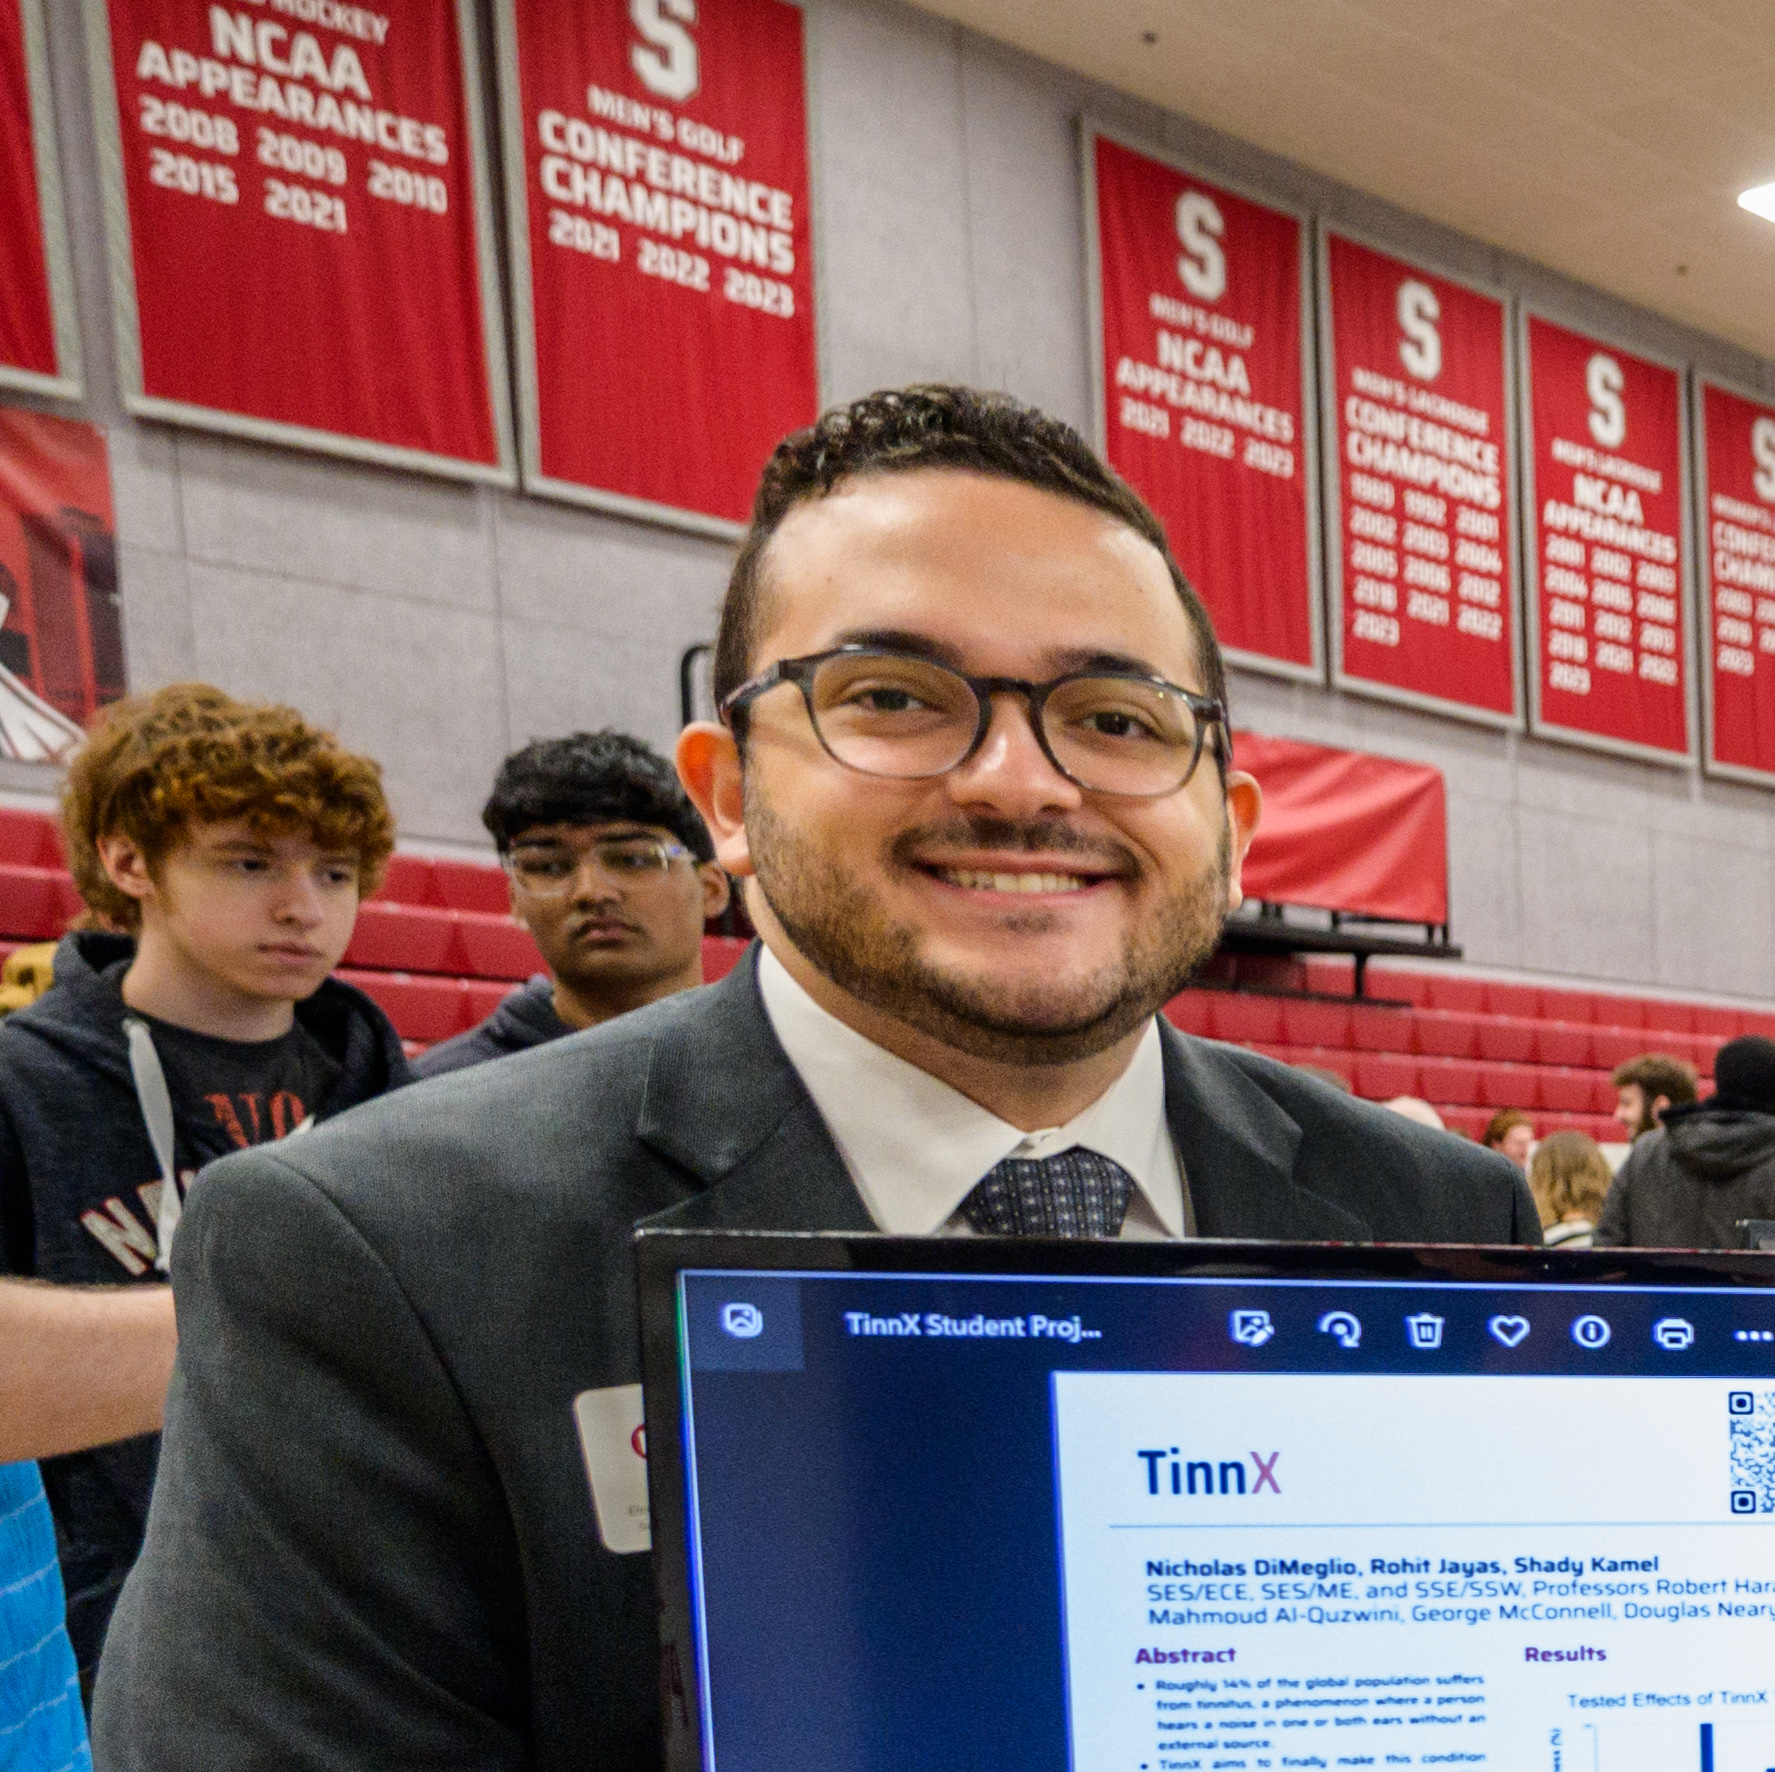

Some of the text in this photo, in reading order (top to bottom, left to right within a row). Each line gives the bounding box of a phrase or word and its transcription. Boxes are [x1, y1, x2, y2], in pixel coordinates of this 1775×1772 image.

[209, 4, 373, 100] NCAA
[628, 0, 699, 102] S
[137, 39, 450, 165] APPEARANCES
[588, 84, 744, 165] MEN'S GOLF
[139, 94, 448, 215] 2008 2009 2010
[151, 148, 347, 234] 2015 2021
[537, 108, 794, 231] CONFERENCE
[540, 153, 795, 275] CHAMPIONS
[1175, 190, 1227, 303] S
[549, 208, 795, 319] 2021 2022 2023
[1150, 292, 1209, 335] MEN'S
[1396, 279, 1442, 382] S
[1116, 356, 1294, 443] APPEARANCES
[1156, 329, 1250, 396] NCAA
[1586, 353, 1626, 448] S
[1345, 395, 1499, 475] CONFERENCE
[1347, 428, 1501, 509] CHAMPIONS
[1543, 498, 1677, 565] APPEARANCES
[1573, 472, 1645, 526] NCAA
[846, 1311, 1103, 1342] TinnX Student Proj...
[1137, 1447, 1283, 1496] TinnX
[1146, 1555, 1659, 1581] Nicholas DiMeglio, Rohit Jayas, Shady Kamel
[1366, 1580, 1408, 1599] and
[1414, 1578, 1527, 1600] SSE/SSW,
[1533, 1578, 1650, 1598] Professors
[1656, 1577, 1728, 1596] Robert
[1148, 1606, 1268, 1626] Mahmoud
[1275, 1605, 1407, 1627] Al-Quzwini,
[1411, 1603, 1492, 1627] George
[1498, 1602, 1618, 1622] McConnell,
[1623, 1601, 1711, 1624] Douglas
[1134, 1646, 1237, 1666] Abstract
[1155, 1678, 1218, 1694] Roughly
[1256, 1676, 1273, 1691] of
[1277, 1677, 1301, 1690] the
[1305, 1676, 1349, 1692] global
[1354, 1675, 1431, 1692] population
[1435, 1673, 1486, 1688] suffers
[1524, 1645, 1608, 1664] Results
[1568, 1692, 1627, 1709] Tested
[1633, 1691, 1692, 1708] Effects
[1697, 1690, 1714, 1707] of
[1719, 1690, 1769, 1706] TinnX
